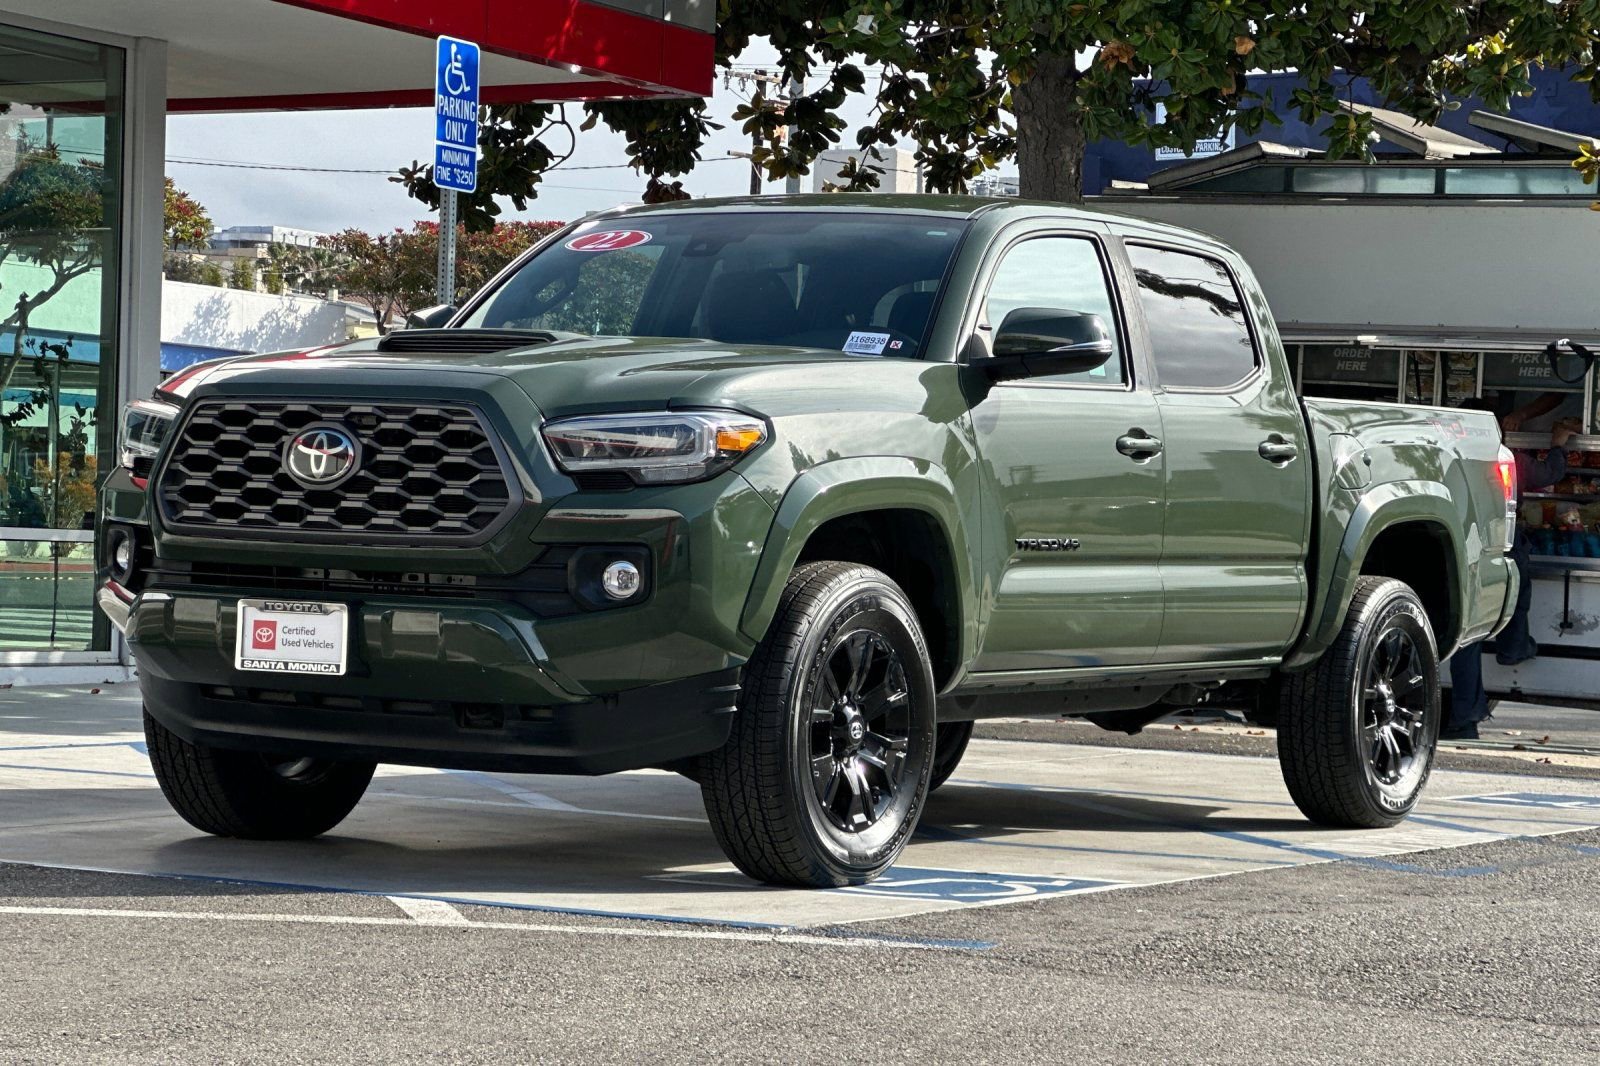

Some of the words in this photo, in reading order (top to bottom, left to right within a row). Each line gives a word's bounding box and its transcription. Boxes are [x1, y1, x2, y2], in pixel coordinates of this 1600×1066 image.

[438, 94, 476, 122] PARKING
[445, 119, 468, 143] ONLY
[441, 149, 470, 168] MINIMUM
[436, 165, 451, 182] FINE
[454, 167, 474, 186] $250
[849, 335, 887, 345] X168938
[1333, 347, 1373, 359] ORDER
[1511, 353, 1540, 364] PICK
[1335, 360, 1368, 371] HERE
[1518, 366, 1551, 378] HERE
[1015, 537, 1080, 552] TACOMA
[265, 602, 321, 613] TOYOTA
[282, 626, 316, 636] Certified
[281, 638, 301, 647] Used
[302, 639, 334, 650] Vehicles
[243, 660, 286, 670] SANTA
[287, 662, 337, 673] MONICA
